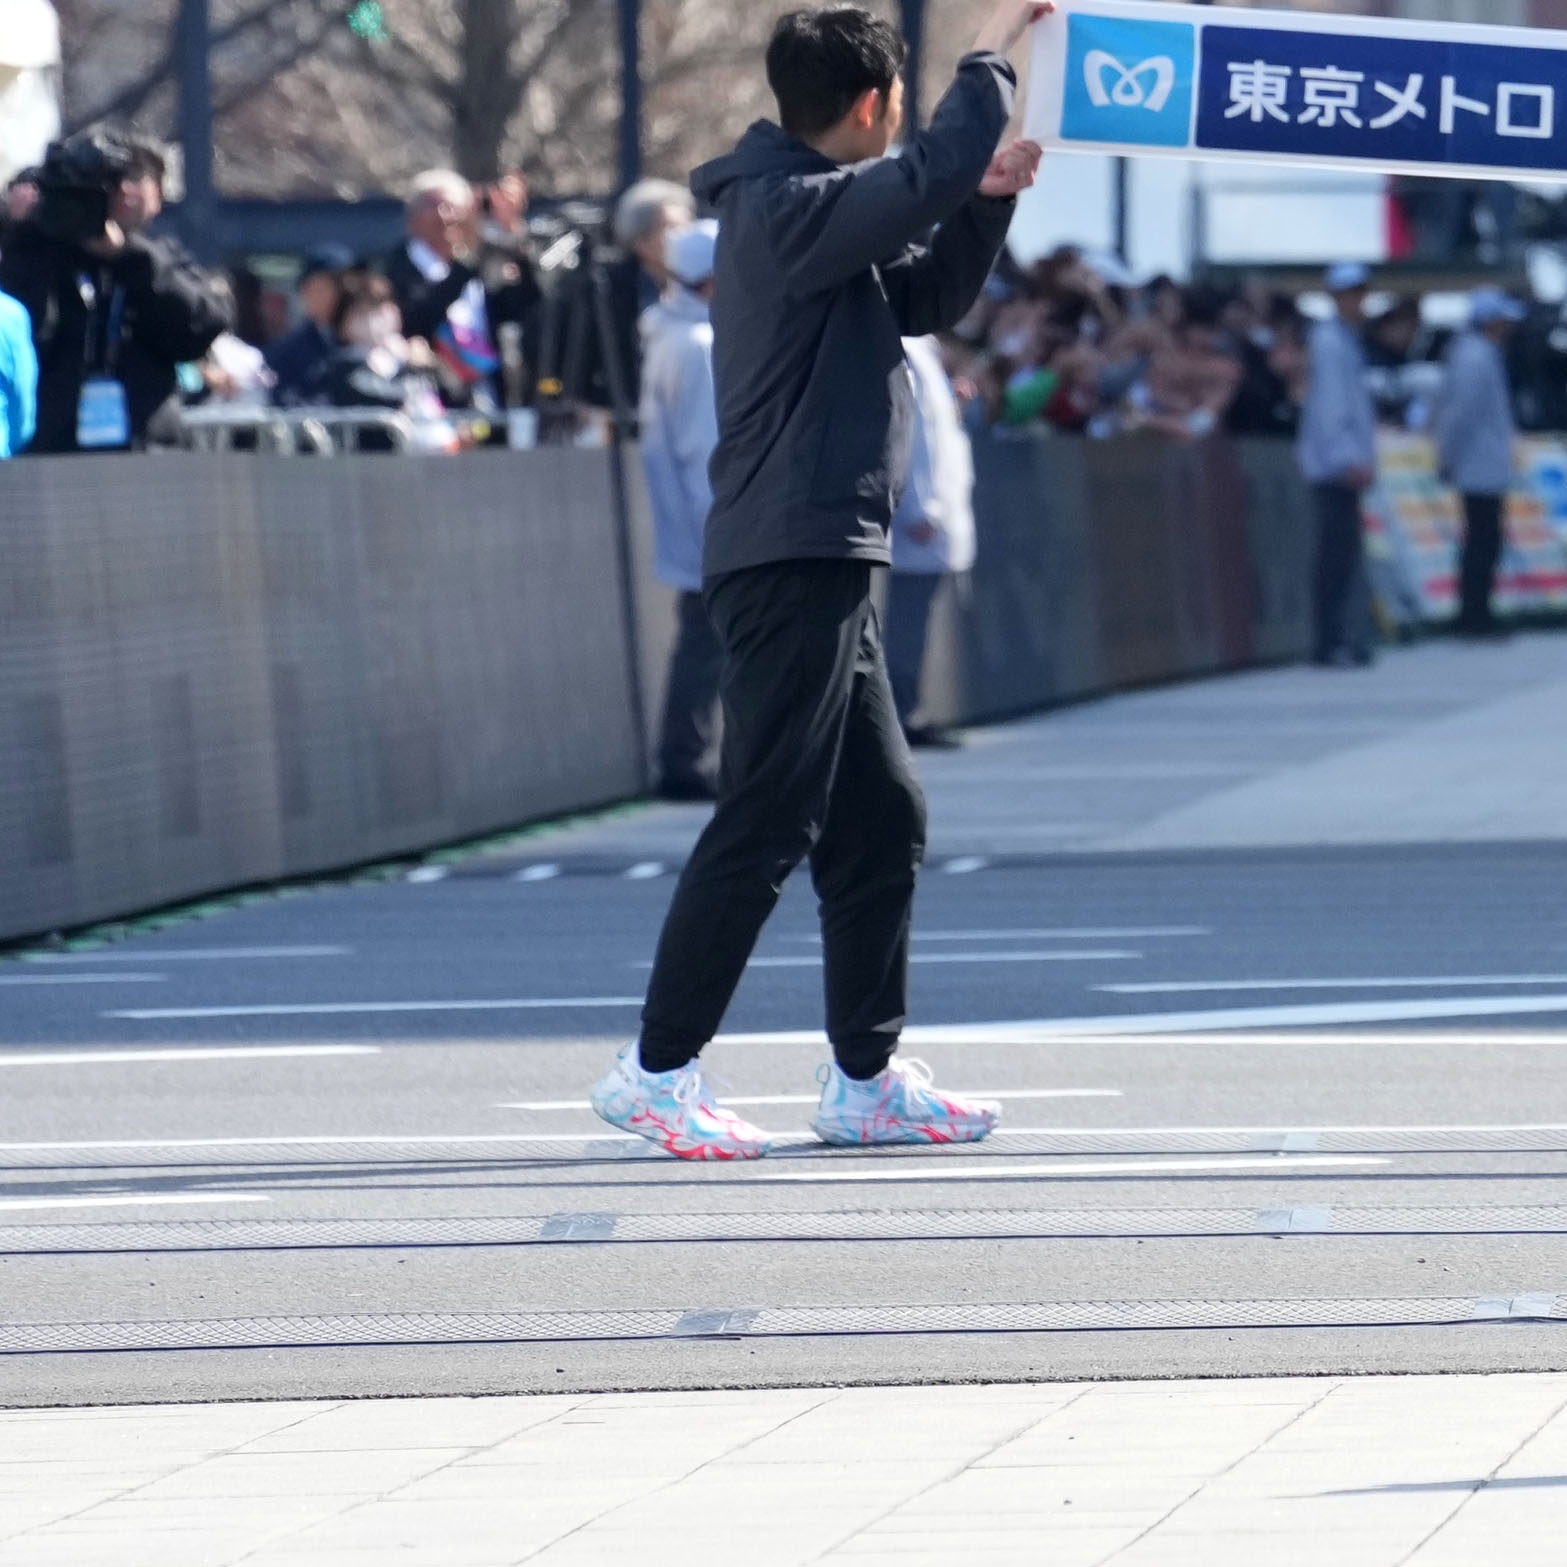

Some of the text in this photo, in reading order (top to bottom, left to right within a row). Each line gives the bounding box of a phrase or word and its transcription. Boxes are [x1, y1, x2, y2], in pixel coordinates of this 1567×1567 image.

[1224, 60, 1554, 139] 東京メトロ
